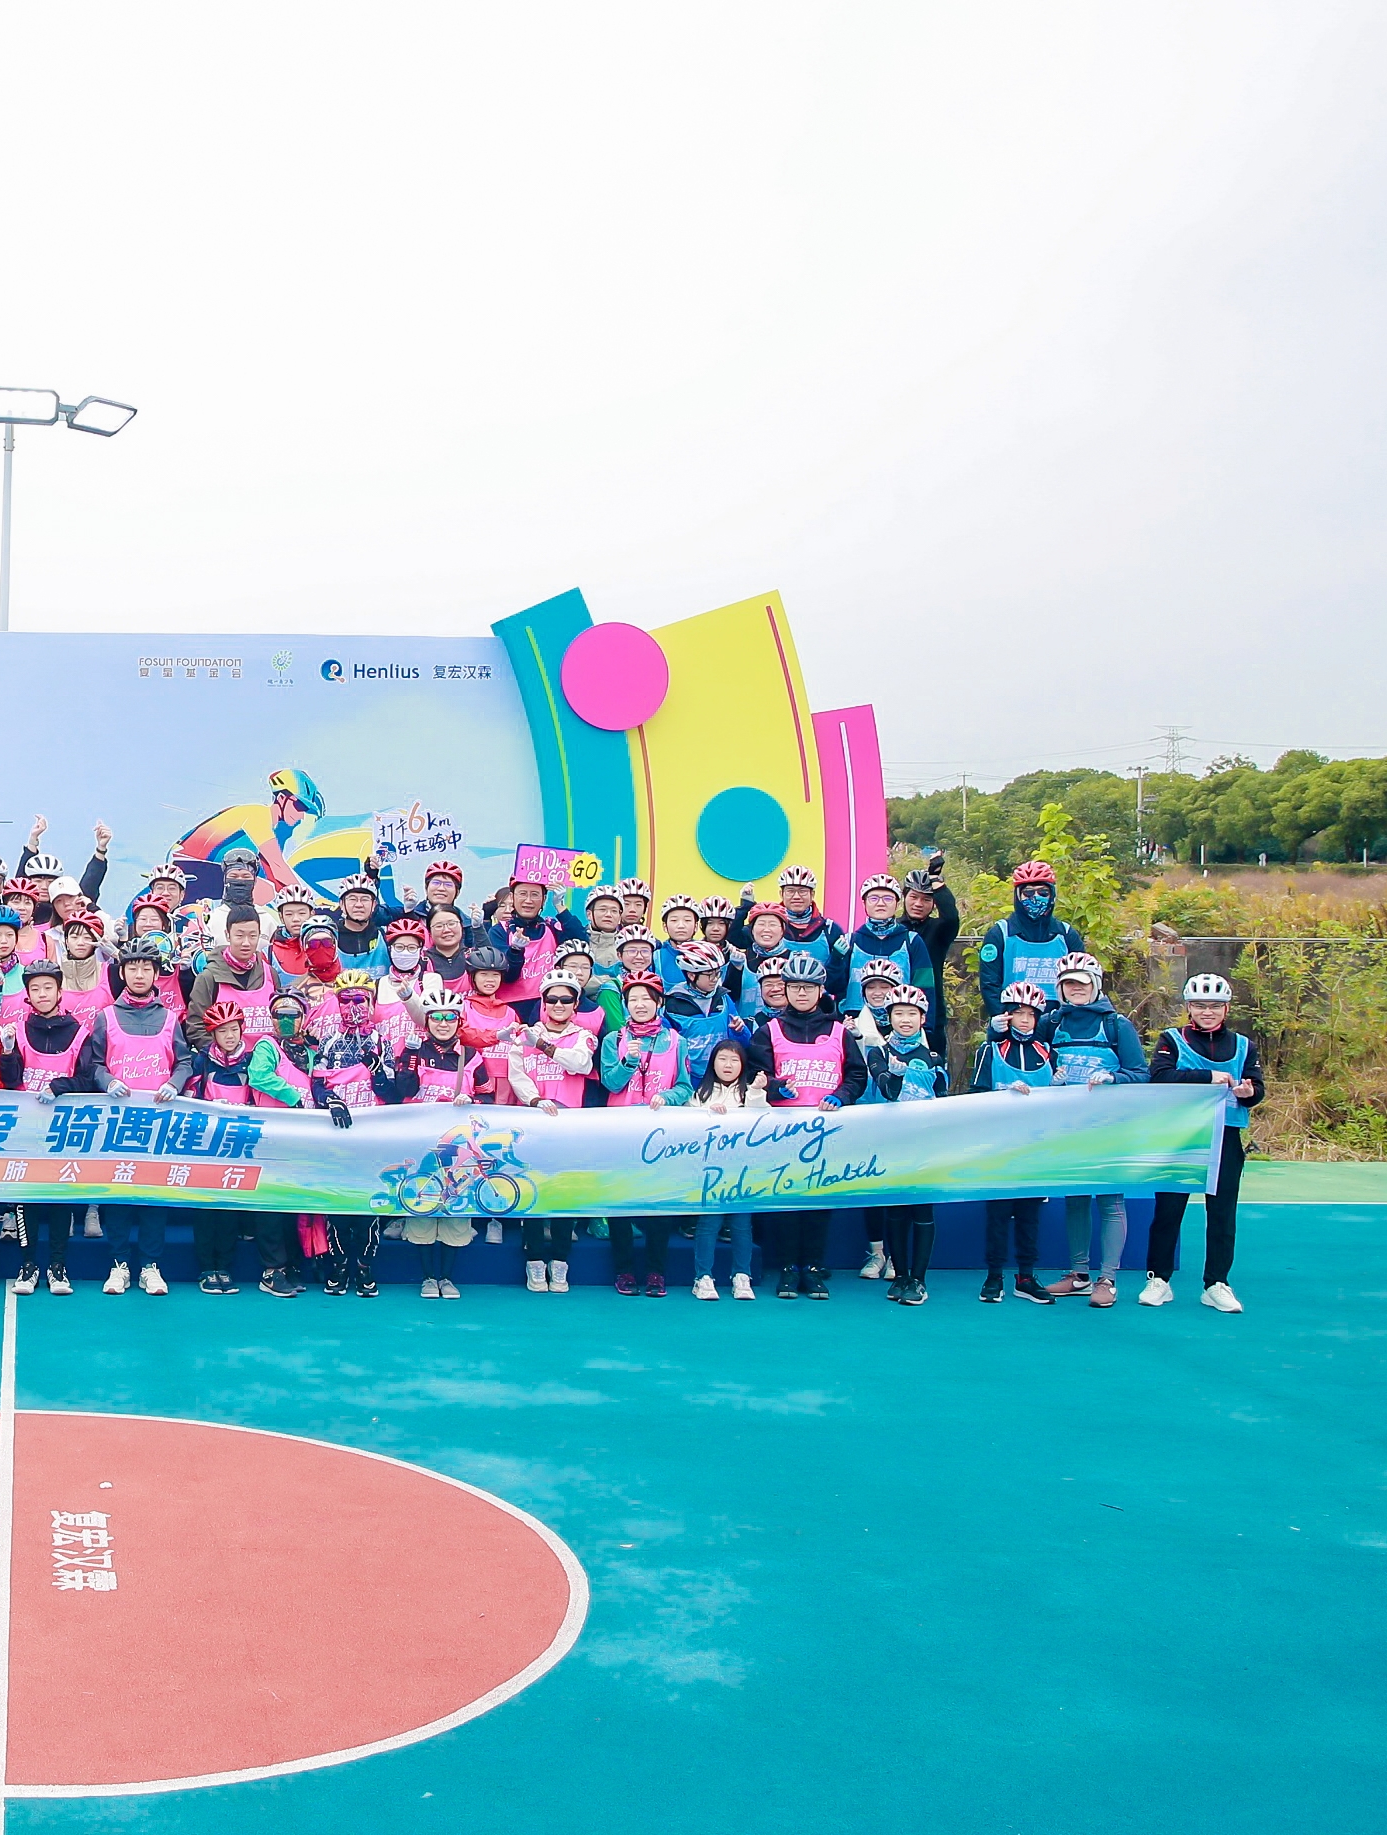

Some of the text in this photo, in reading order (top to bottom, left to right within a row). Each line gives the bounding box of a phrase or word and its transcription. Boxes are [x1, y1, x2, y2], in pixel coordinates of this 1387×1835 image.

[139, 657, 242, 667] FOSUN FOUNDATION
[353, 663, 420, 680] Henlius
[432, 664, 493, 680] 复宏汉霖
[573, 859, 598, 880] GO
[122, 1066, 144, 1080] Ride
[45, 1104, 267, 1160] 骑遇健康
[641, 1112, 844, 1165] Care For Lung
[701, 1154, 887, 1208] Ride To Health
[50, 1510, 118, 1592] 复宏汉霖
